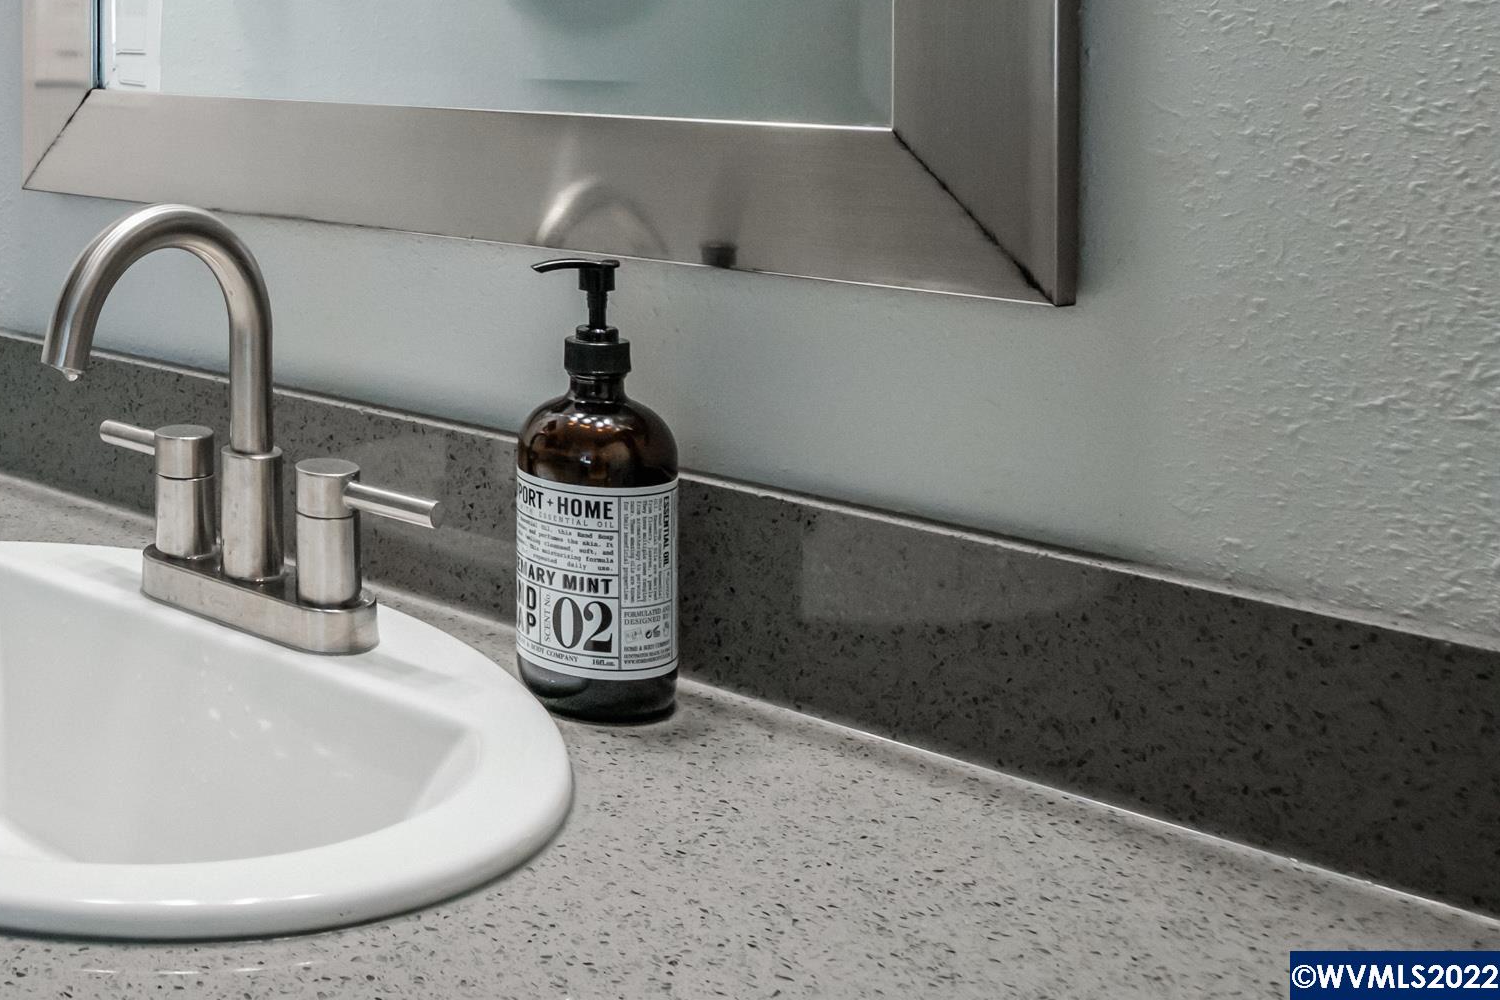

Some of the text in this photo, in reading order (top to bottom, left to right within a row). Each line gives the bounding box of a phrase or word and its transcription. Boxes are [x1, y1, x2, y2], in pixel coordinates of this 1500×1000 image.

[557, 496, 614, 520] HOME
[539, 510, 589, 527] ESSENTIAL
[597, 521, 615, 529] OIL
[562, 574, 613, 595] MINT
[552, 597, 613, 653] 02
[546, 650, 579, 662] COMPANY
